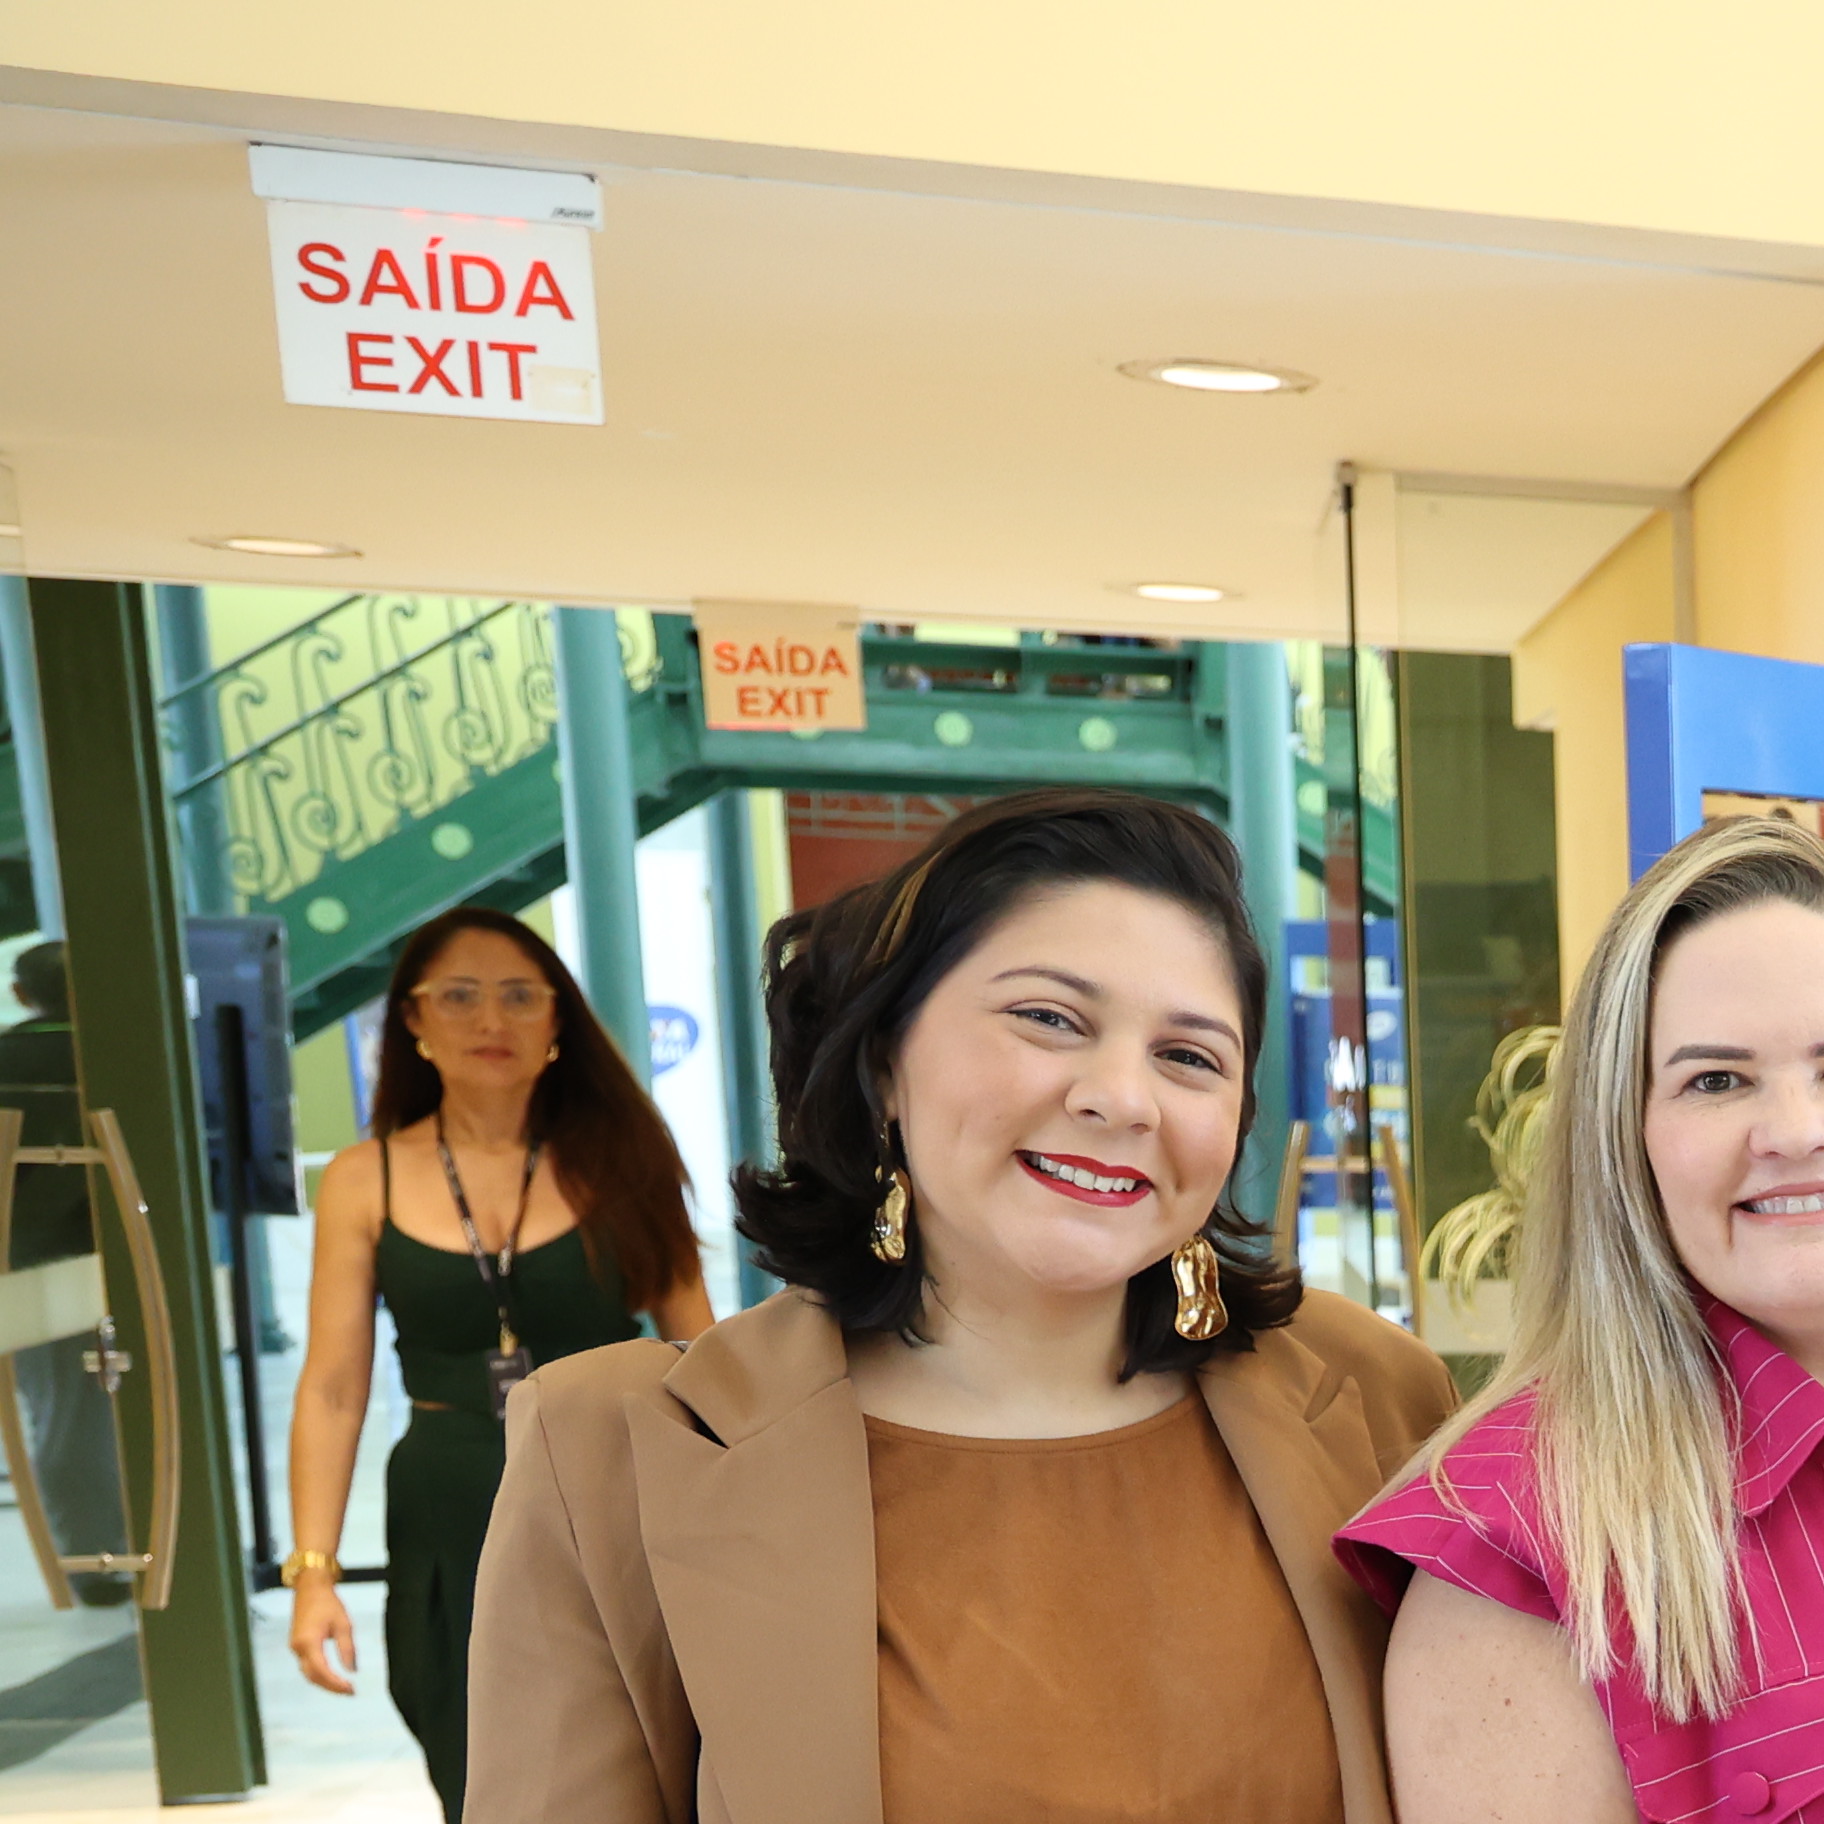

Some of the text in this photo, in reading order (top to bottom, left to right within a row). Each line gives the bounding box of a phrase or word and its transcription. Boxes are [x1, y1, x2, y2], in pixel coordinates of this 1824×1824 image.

[297, 236, 576, 321] SAÍDA
[345, 331, 538, 401] EXIT
[713, 636, 848, 678] SAÍDA
[737, 685, 830, 719] EXIT
